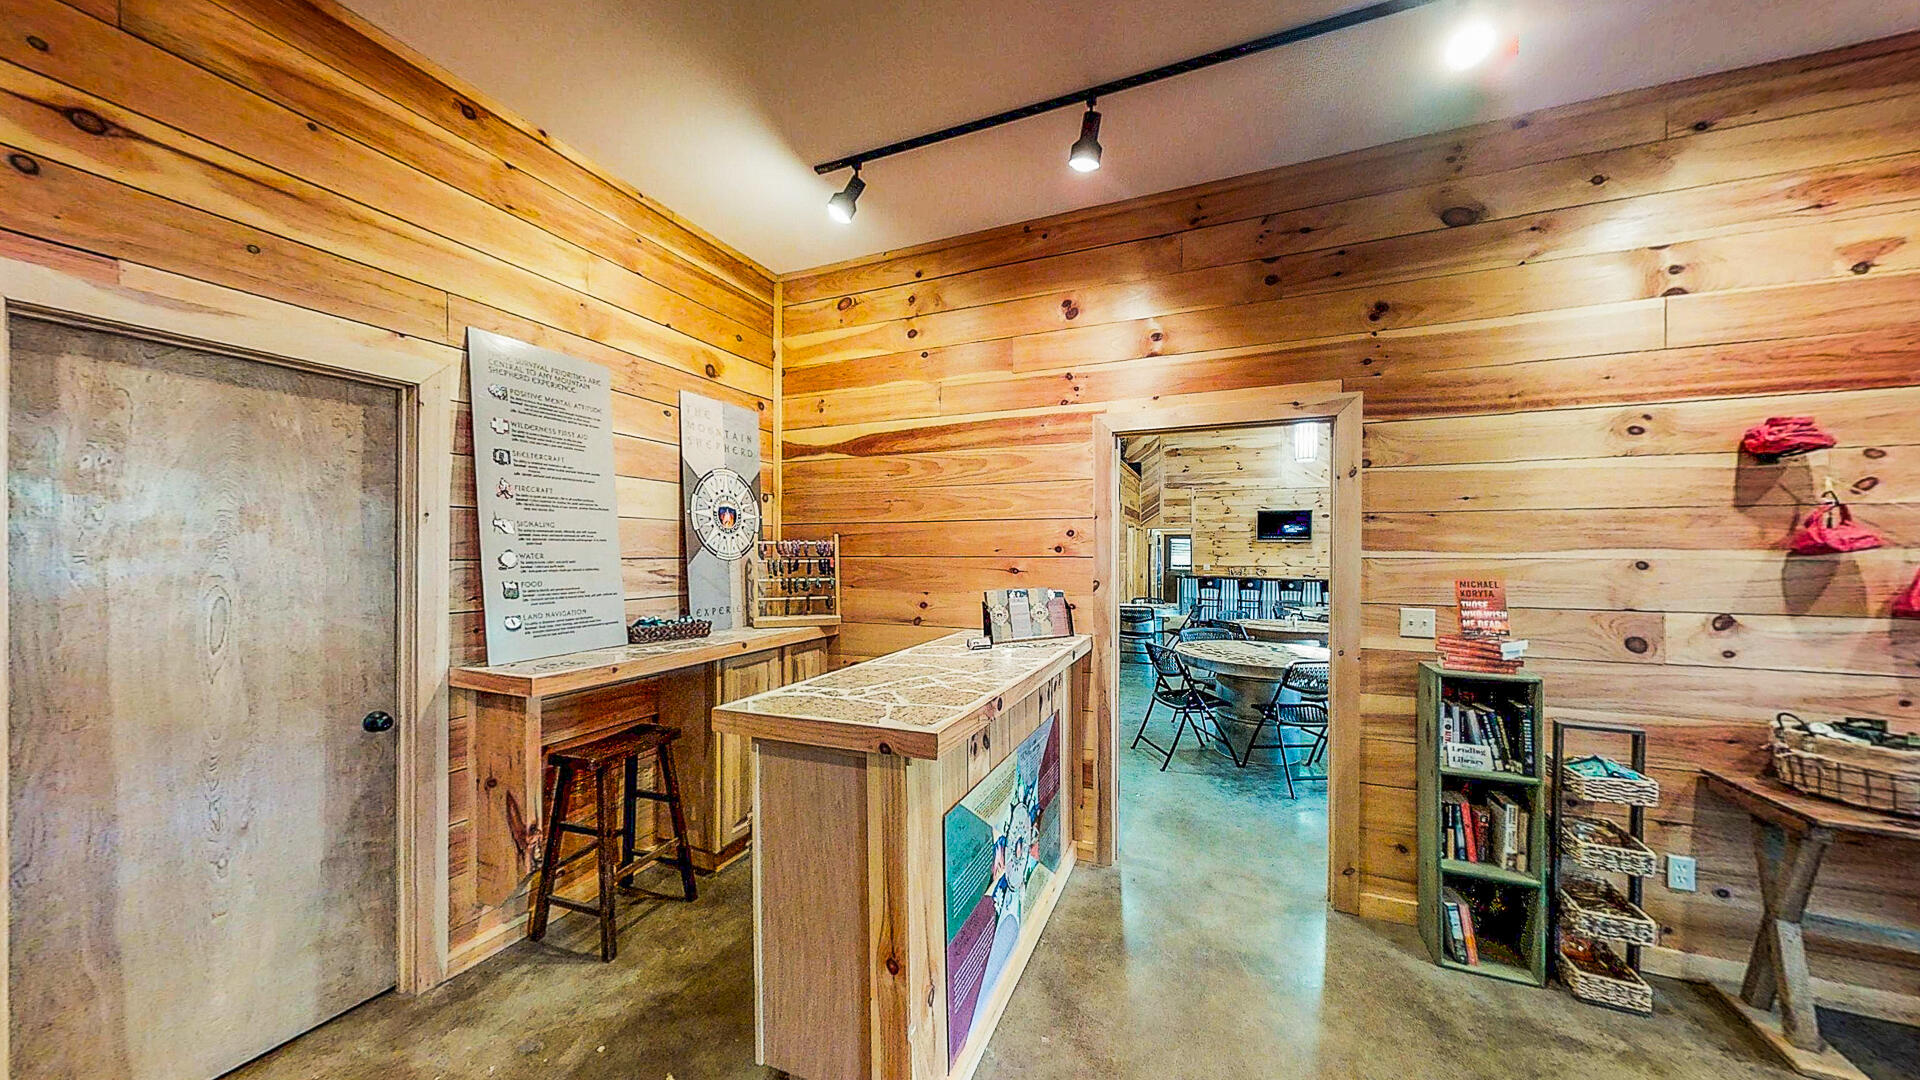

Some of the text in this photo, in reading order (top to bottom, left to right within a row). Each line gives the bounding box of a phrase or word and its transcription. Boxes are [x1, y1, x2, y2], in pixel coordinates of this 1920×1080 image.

[488, 358, 591, 390] CENTRAL TO ANY MOUNTAIN
[488, 365, 577, 394] SHEPHERD EXPERIENCE
[551, 367, 587, 383] PRIORITIES
[588, 377, 601, 387] ARE
[509, 388, 602, 414] POSITIVE MENTAL ATTITUDE
[686, 404, 711, 420] THE
[511, 421, 557, 435] WILDERNESS
[557, 429, 575, 438] FIRST
[686, 420, 752, 444] MOUNTAIN
[687, 436, 754, 458] SHEPHERD
[512, 450, 565, 463] SHELTERCRAFT
[514, 484, 553, 494] FIRECRAFT
[516, 520, 555, 529] SIGNALING
[518, 552, 544, 560] WATER
[521, 580, 543, 588] FOOD
[1459, 580, 1500, 589] MICHAEL
[1459, 590, 1495, 598] KORYTA
[1460, 600, 1489, 609] THOSE
[522, 608, 587, 621] LAND NAVIGATION
[1461, 609, 1508, 619] WHO WISH
[1462, 619, 1502, 628] ME DEAD
[1451, 745, 1487, 756] Lending
[1452, 756, 1484, 766] Library
